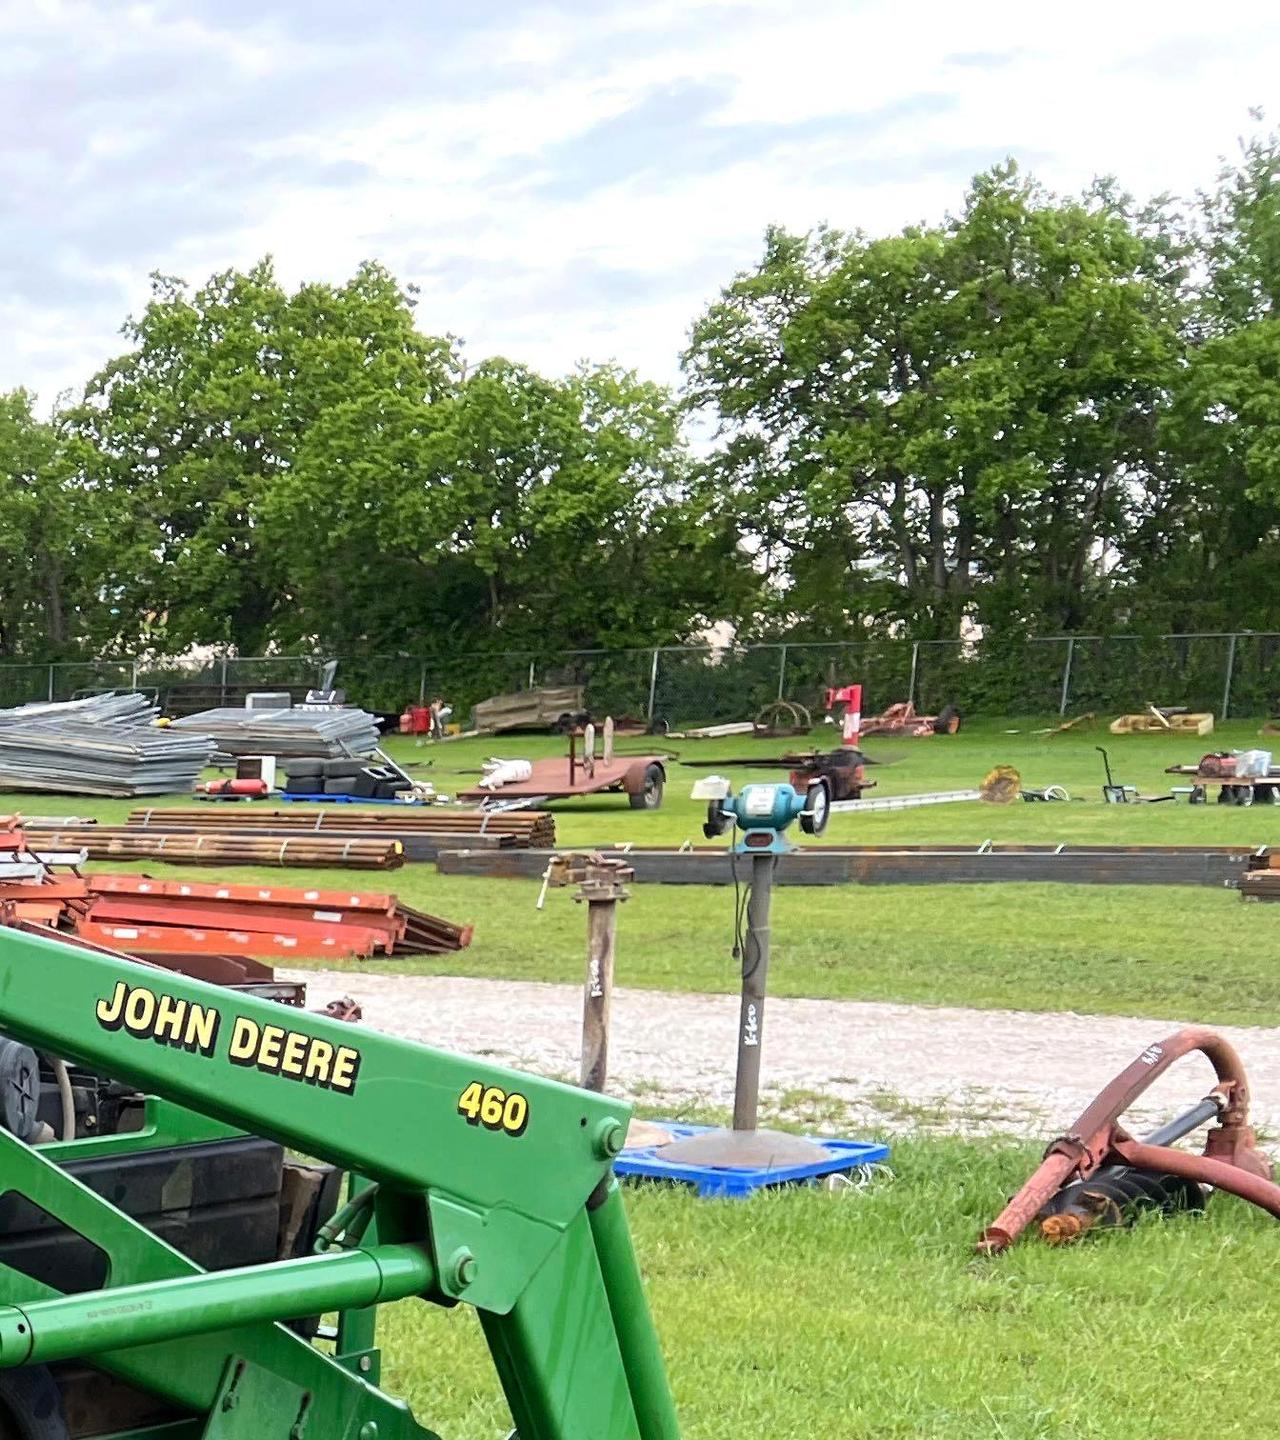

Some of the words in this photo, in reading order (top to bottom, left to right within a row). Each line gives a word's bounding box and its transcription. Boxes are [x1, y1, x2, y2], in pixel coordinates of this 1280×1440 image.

[96, 981, 221, 1059] JOHN
[228, 1014, 362, 1097] DEERE
[456, 1080, 530, 1138] 460
